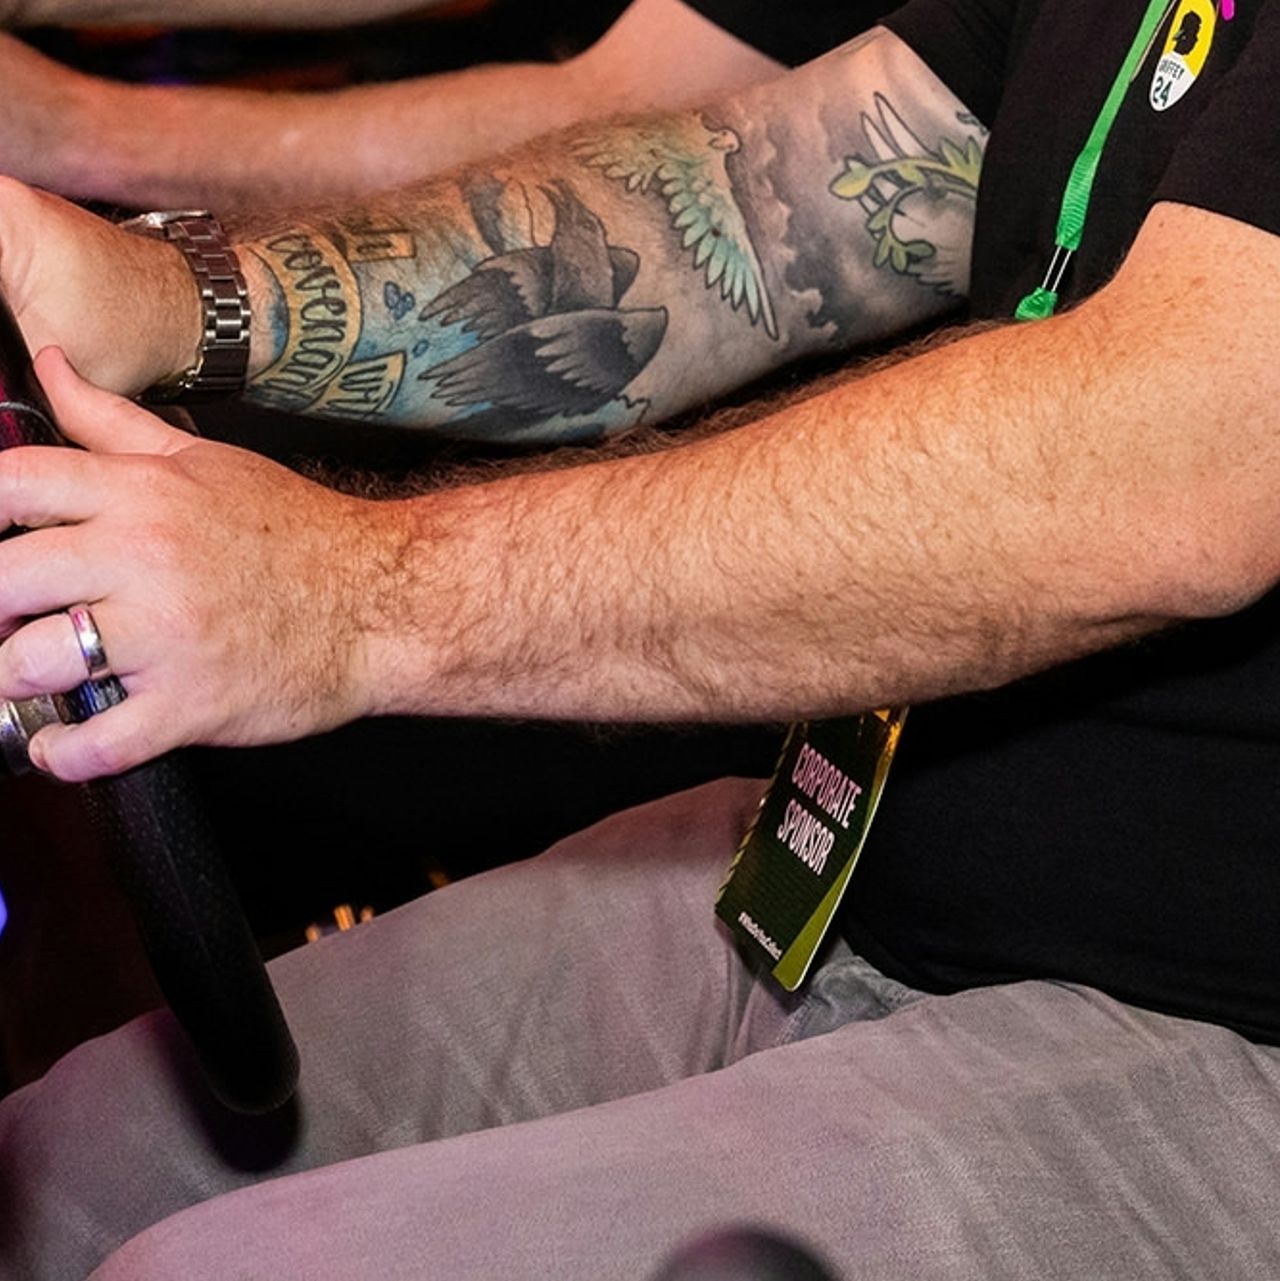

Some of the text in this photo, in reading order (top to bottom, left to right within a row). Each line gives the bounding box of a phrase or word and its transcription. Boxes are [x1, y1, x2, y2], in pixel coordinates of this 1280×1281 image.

[1153, 76, 1172, 107] 24
[792, 742, 862, 829] CORPORATE
[777, 798, 835, 876] SPONSOR
